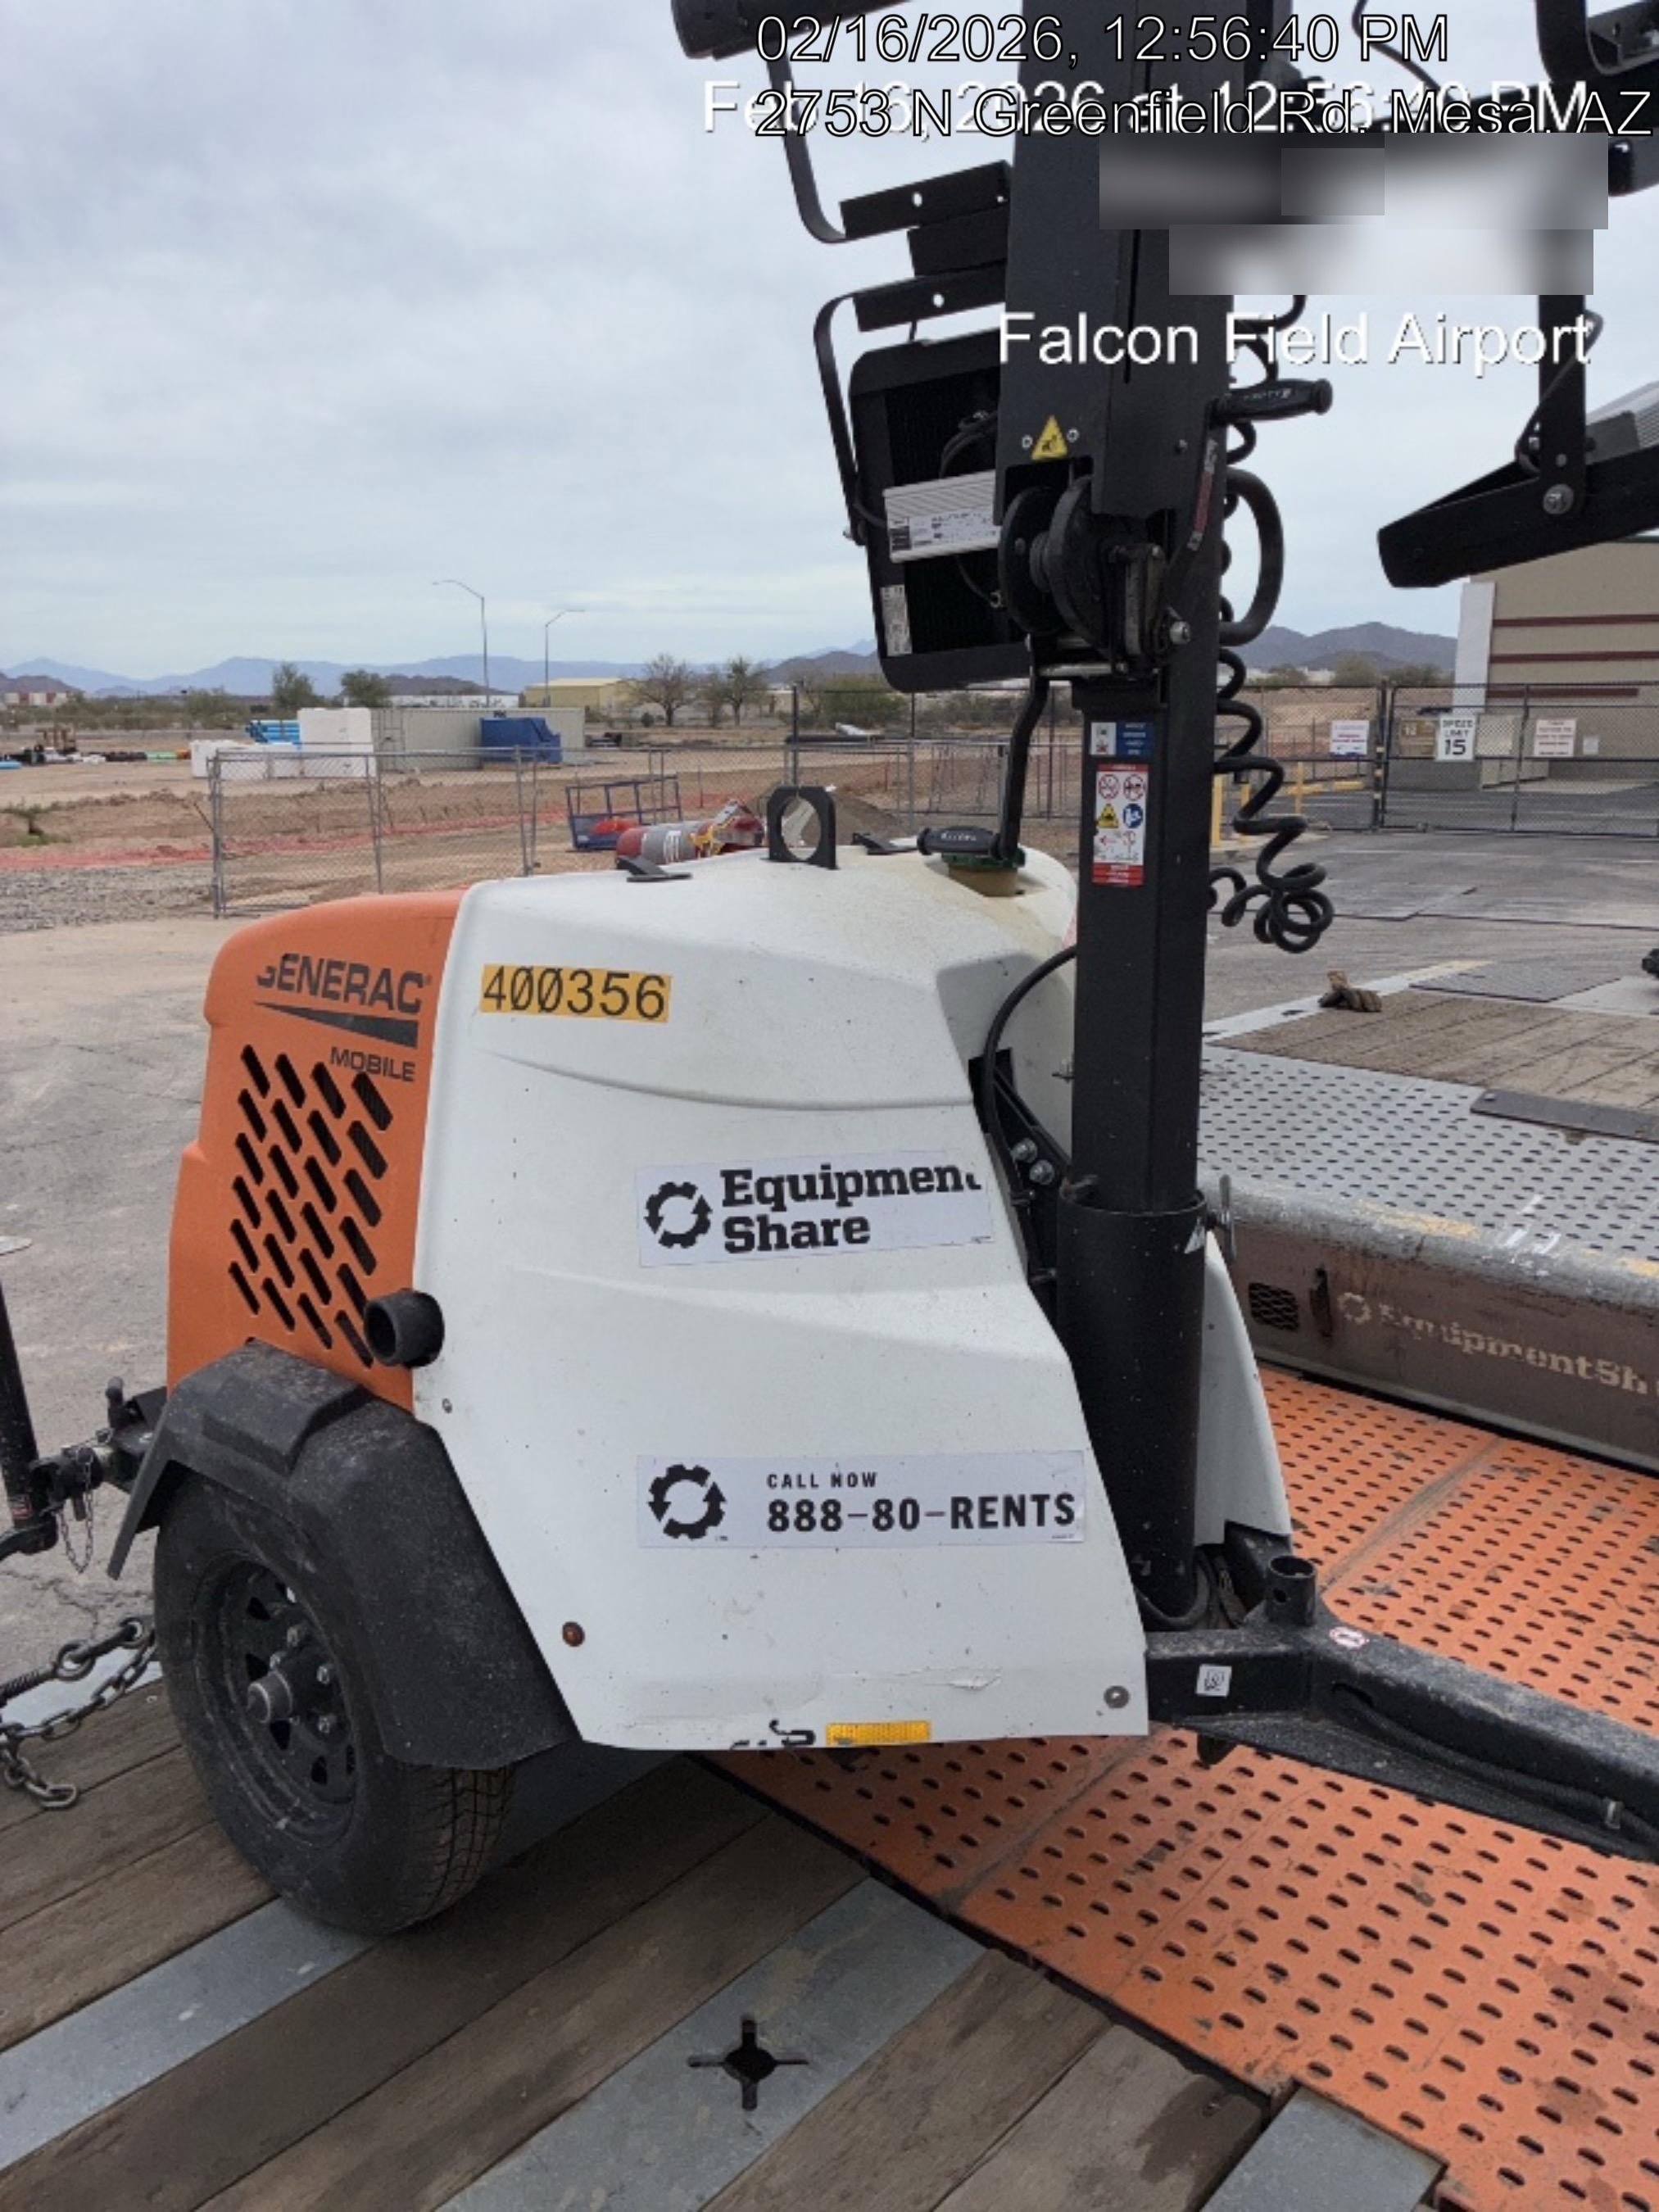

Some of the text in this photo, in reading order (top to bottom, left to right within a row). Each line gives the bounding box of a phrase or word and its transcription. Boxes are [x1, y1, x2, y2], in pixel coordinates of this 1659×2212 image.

[1444, 739, 1466, 755] 15
[483, 965, 667, 1019] 400356
[330, 1046, 416, 1081] MOBILE
[723, 1213, 871, 1254] Share
[767, 1471, 878, 1489] CALL NOW
[767, 1492, 1077, 1533] 888-80-RENTS
